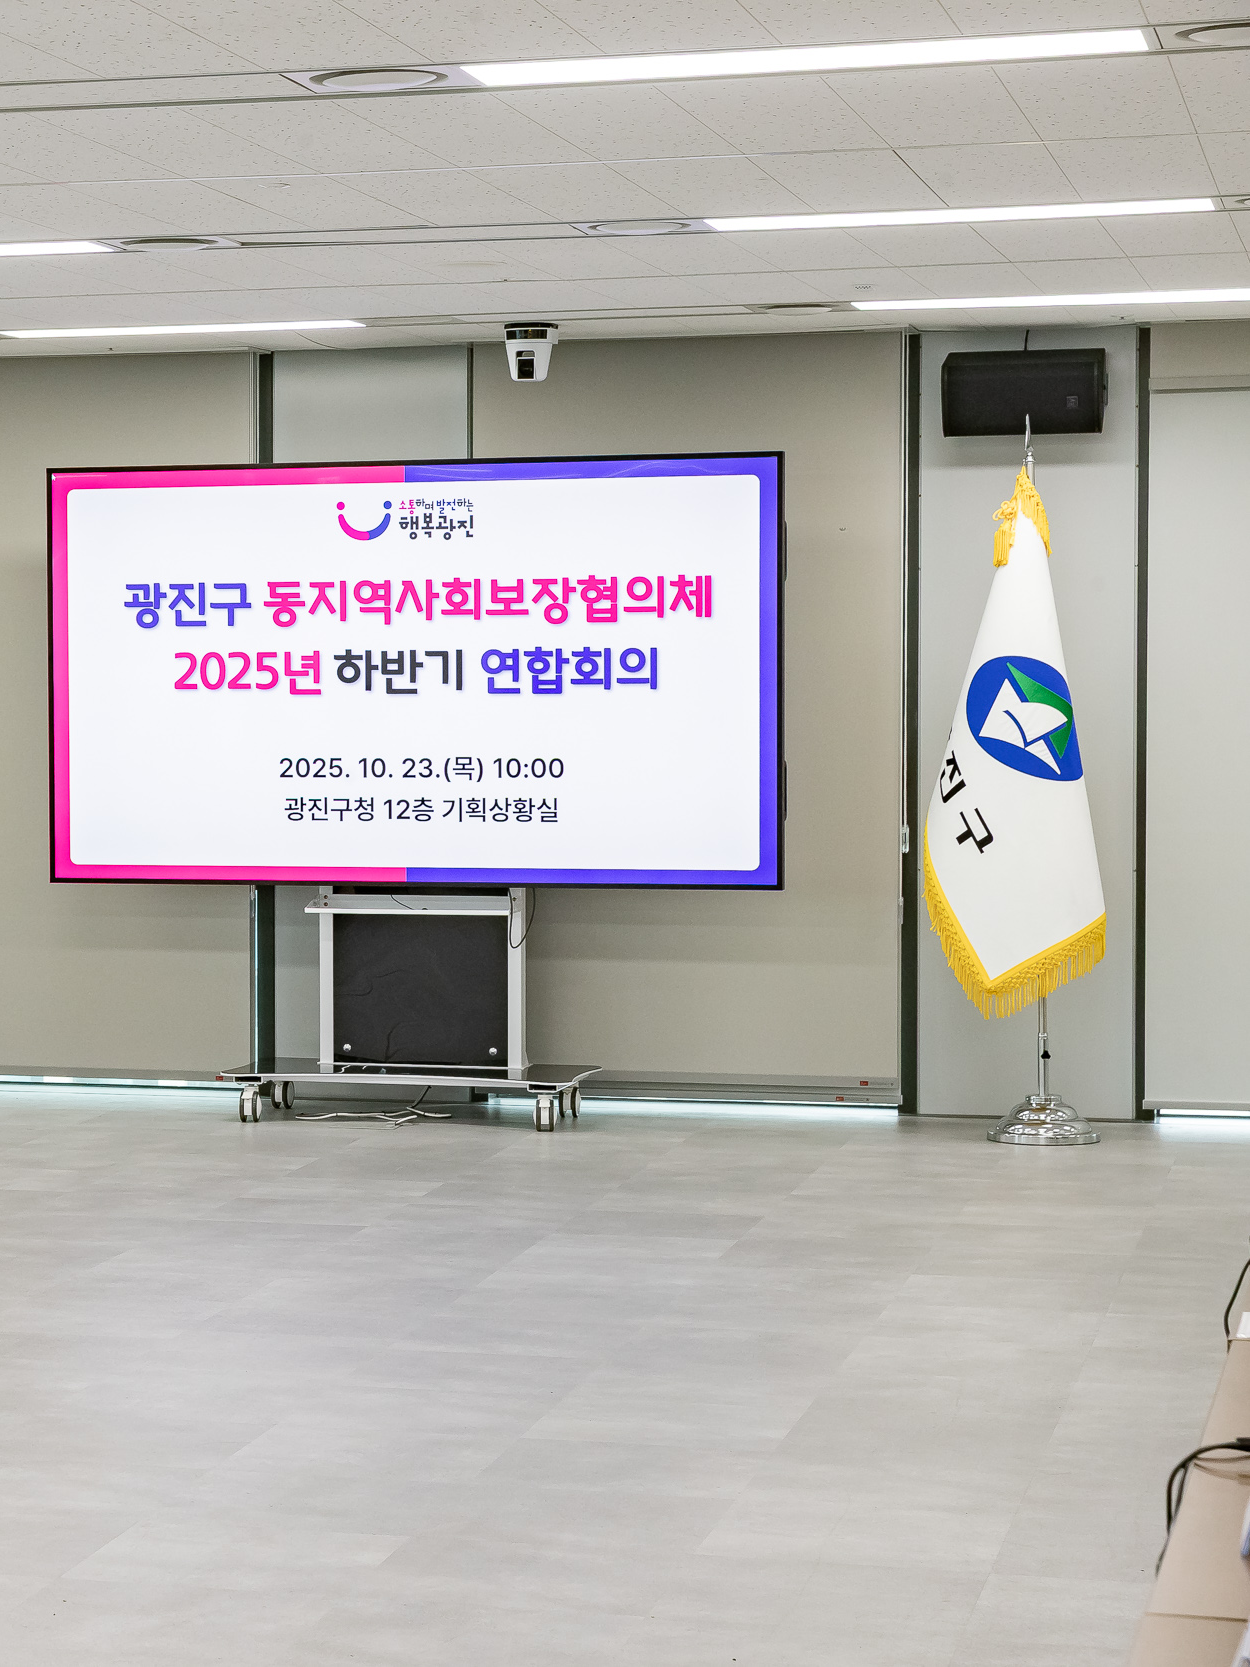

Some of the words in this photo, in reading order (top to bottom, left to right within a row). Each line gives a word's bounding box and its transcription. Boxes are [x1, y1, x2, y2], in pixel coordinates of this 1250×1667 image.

[399, 498, 434, 514] 소통하며
[436, 498, 474, 514] 발전하는
[399, 513, 474, 540] 행복광진
[124, 582, 252, 629] 광진구
[264, 575, 713, 627] 동지역사회보장협의체
[174, 650, 322, 695] 2025년
[334, 649, 463, 694] 하반기
[481, 646, 658, 694] 연합회의
[279, 758, 350, 779] 2025.
[359, 758, 393, 779] 10.
[402, 757, 484, 783] 23.(목)
[493, 758, 565, 779] 10:00
[939, 727, 994, 854] 진구
[284, 797, 375, 822] 광진구청
[384, 797, 435, 822] 12층
[442, 797, 559, 823] 기획상황실
